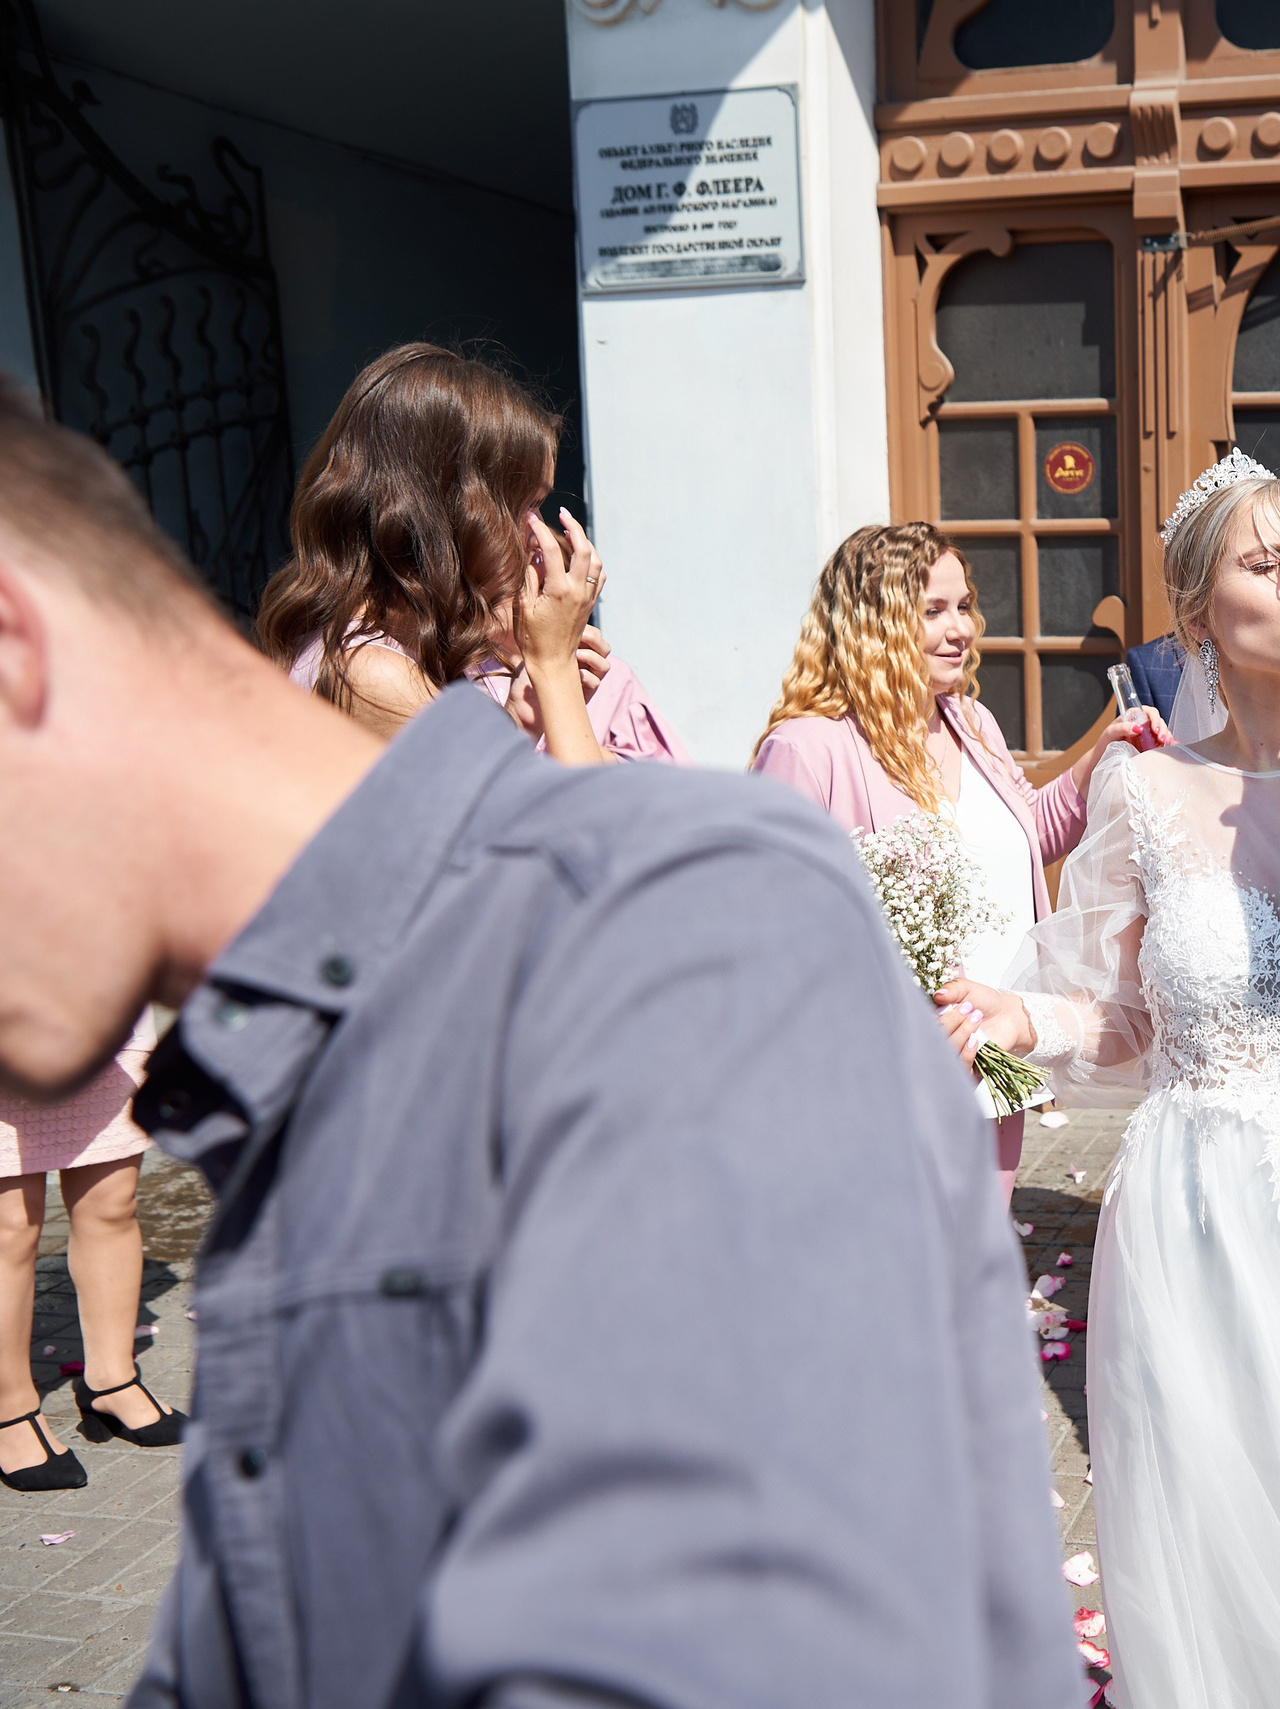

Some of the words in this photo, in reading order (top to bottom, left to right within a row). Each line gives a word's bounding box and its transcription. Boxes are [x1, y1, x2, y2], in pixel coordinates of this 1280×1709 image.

[611, 184, 652, 203] ДОМ
[673, 181, 692, 197] Ф.
[696, 177, 764, 196] ФЛЕЕРА
